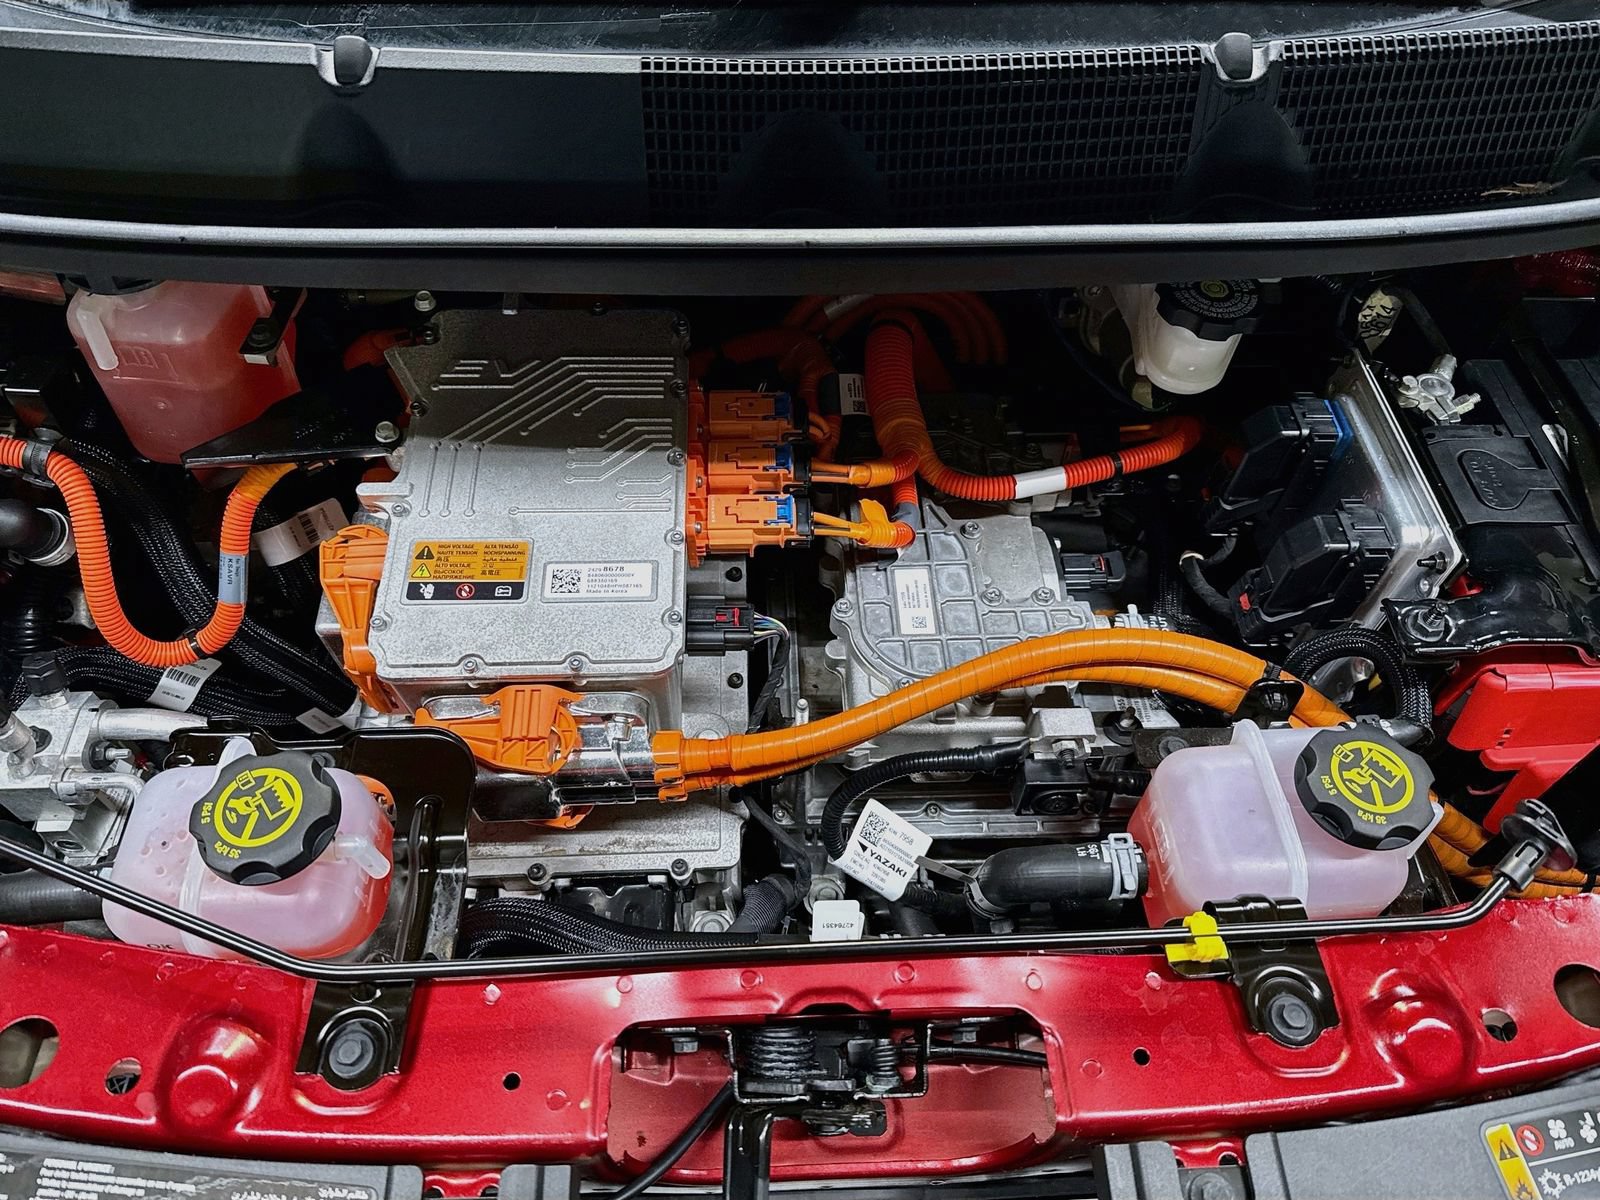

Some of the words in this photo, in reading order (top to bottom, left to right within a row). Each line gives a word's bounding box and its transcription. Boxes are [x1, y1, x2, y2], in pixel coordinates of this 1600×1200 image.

[1320, 775, 1333, 789] PSI
[201, 802, 213, 817] PSI
[1357, 809, 1375, 822] kPa
[201, 817, 211, 825] 5
[1375, 815, 1388, 825] 35
[228, 848, 242, 859] 35
[869, 849, 908, 878] YAZAKI
